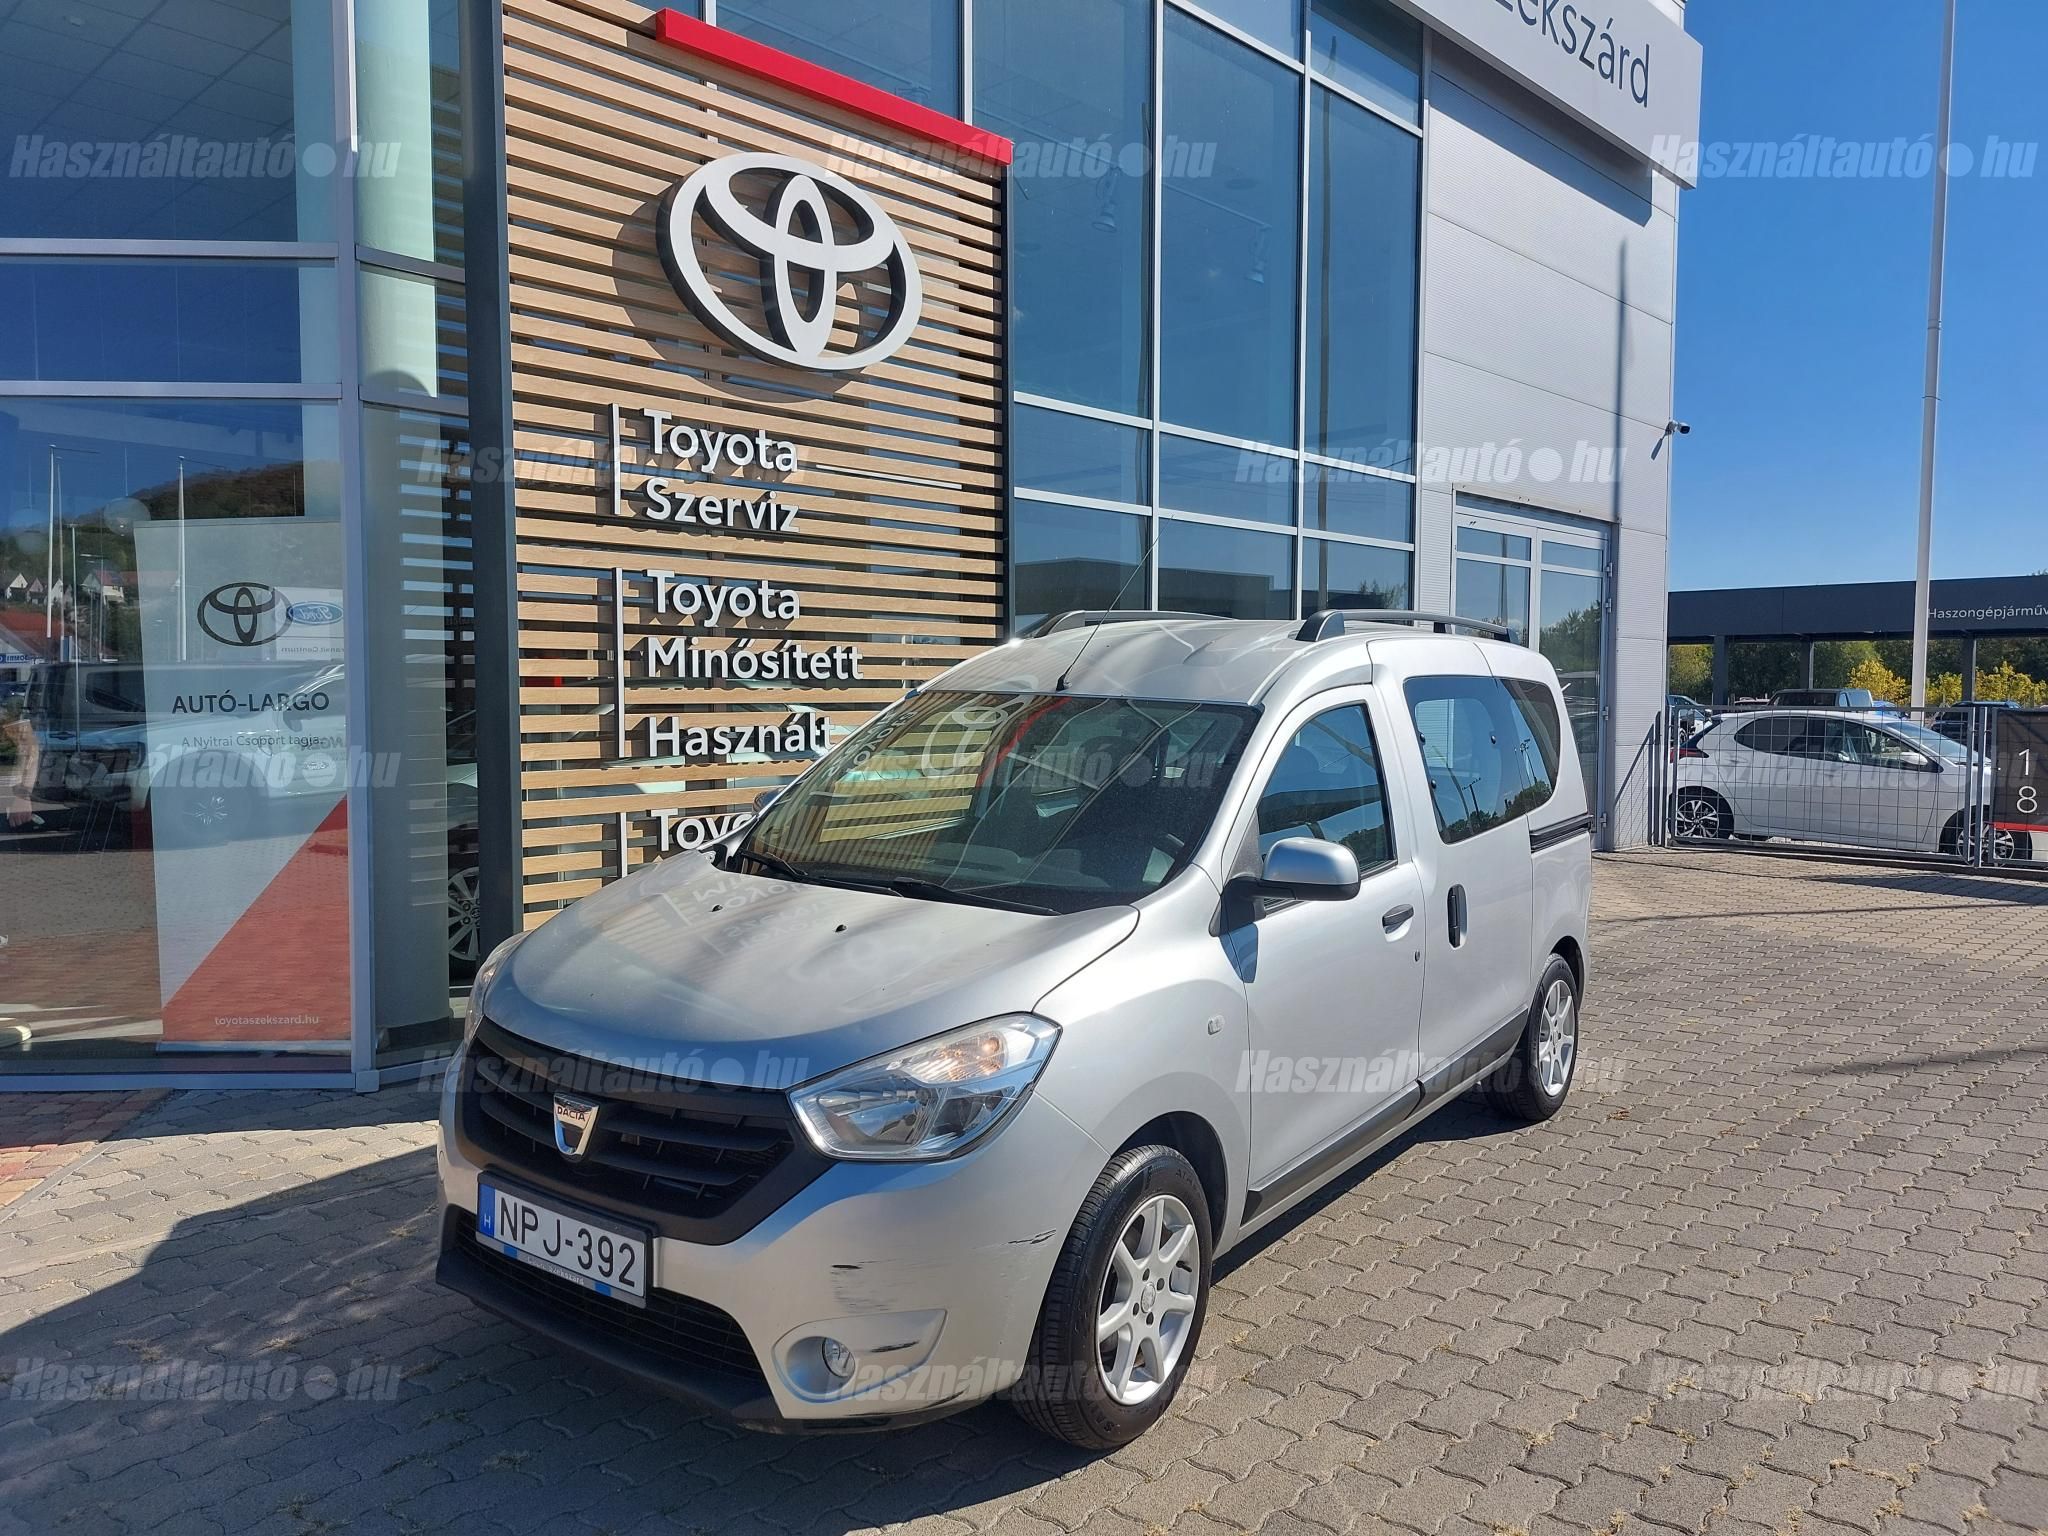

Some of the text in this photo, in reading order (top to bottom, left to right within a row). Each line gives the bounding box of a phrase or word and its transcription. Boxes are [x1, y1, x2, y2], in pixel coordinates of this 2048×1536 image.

[642, 408, 798, 474] Toyota
[645, 477, 800, 534] Szerviz
[645, 569, 801, 628] Toyota
[646, 634, 865, 681] Minősített
[171, 690, 330, 714] AUTÓ-LARGO
[182, 736, 193, 746] A
[194, 735, 233, 748] Nyitrai
[236, 735, 286, 749] Csoport
[648, 711, 836, 758] Használt
[2018, 748, 2030, 776] 1
[2016, 785, 2038, 814] 8
[215, 1013, 319, 1027] toyotaszekszard.hu
[556, 1105, 587, 1122] DACIA
[483, 1214, 491, 1227] H
[500, 1197, 636, 1288] NPJ-392
